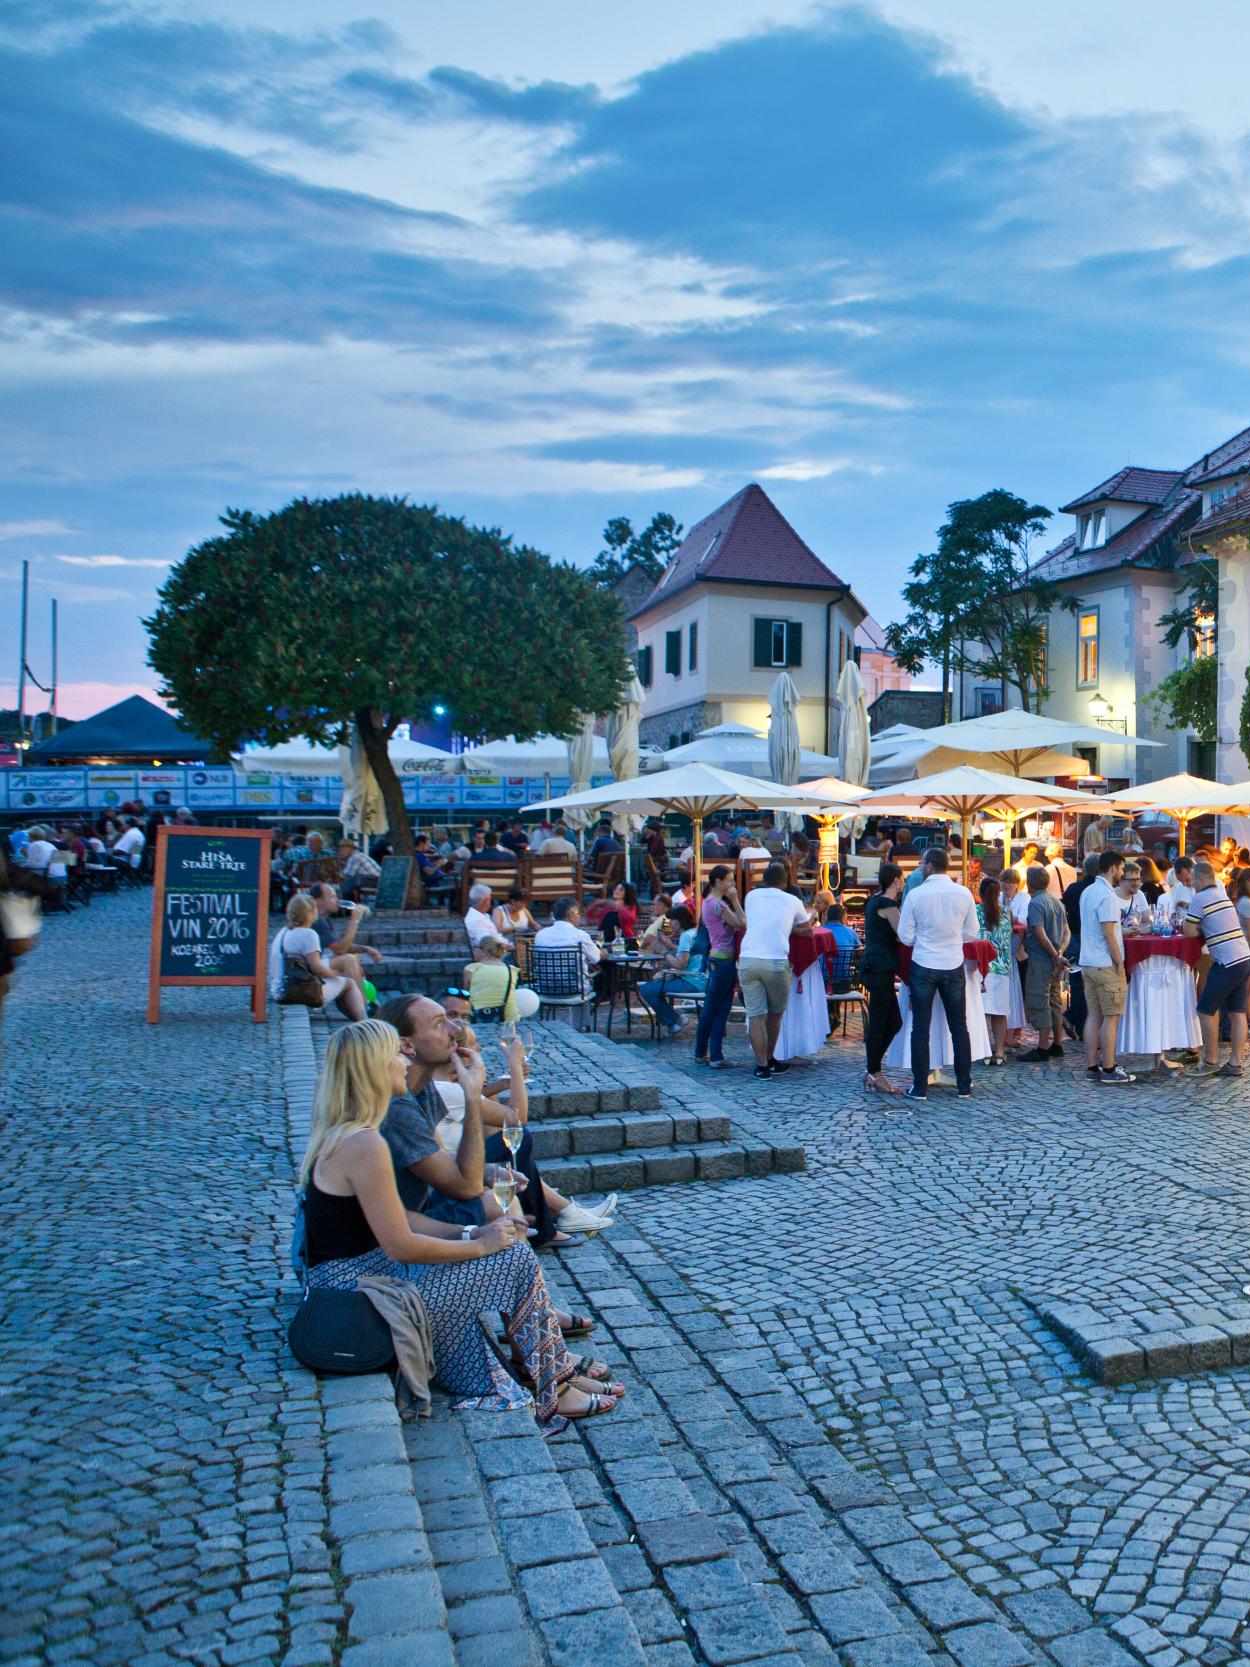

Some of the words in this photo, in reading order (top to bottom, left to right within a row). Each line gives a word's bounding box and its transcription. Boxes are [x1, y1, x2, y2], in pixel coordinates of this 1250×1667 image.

[402, 758, 447, 773] Coca-Cola
[167, 894, 248, 915] FESTIVAL
[168, 919, 200, 939] VIN
[207, 917, 250, 939] 2016
[218, 944, 241, 954] VINA
